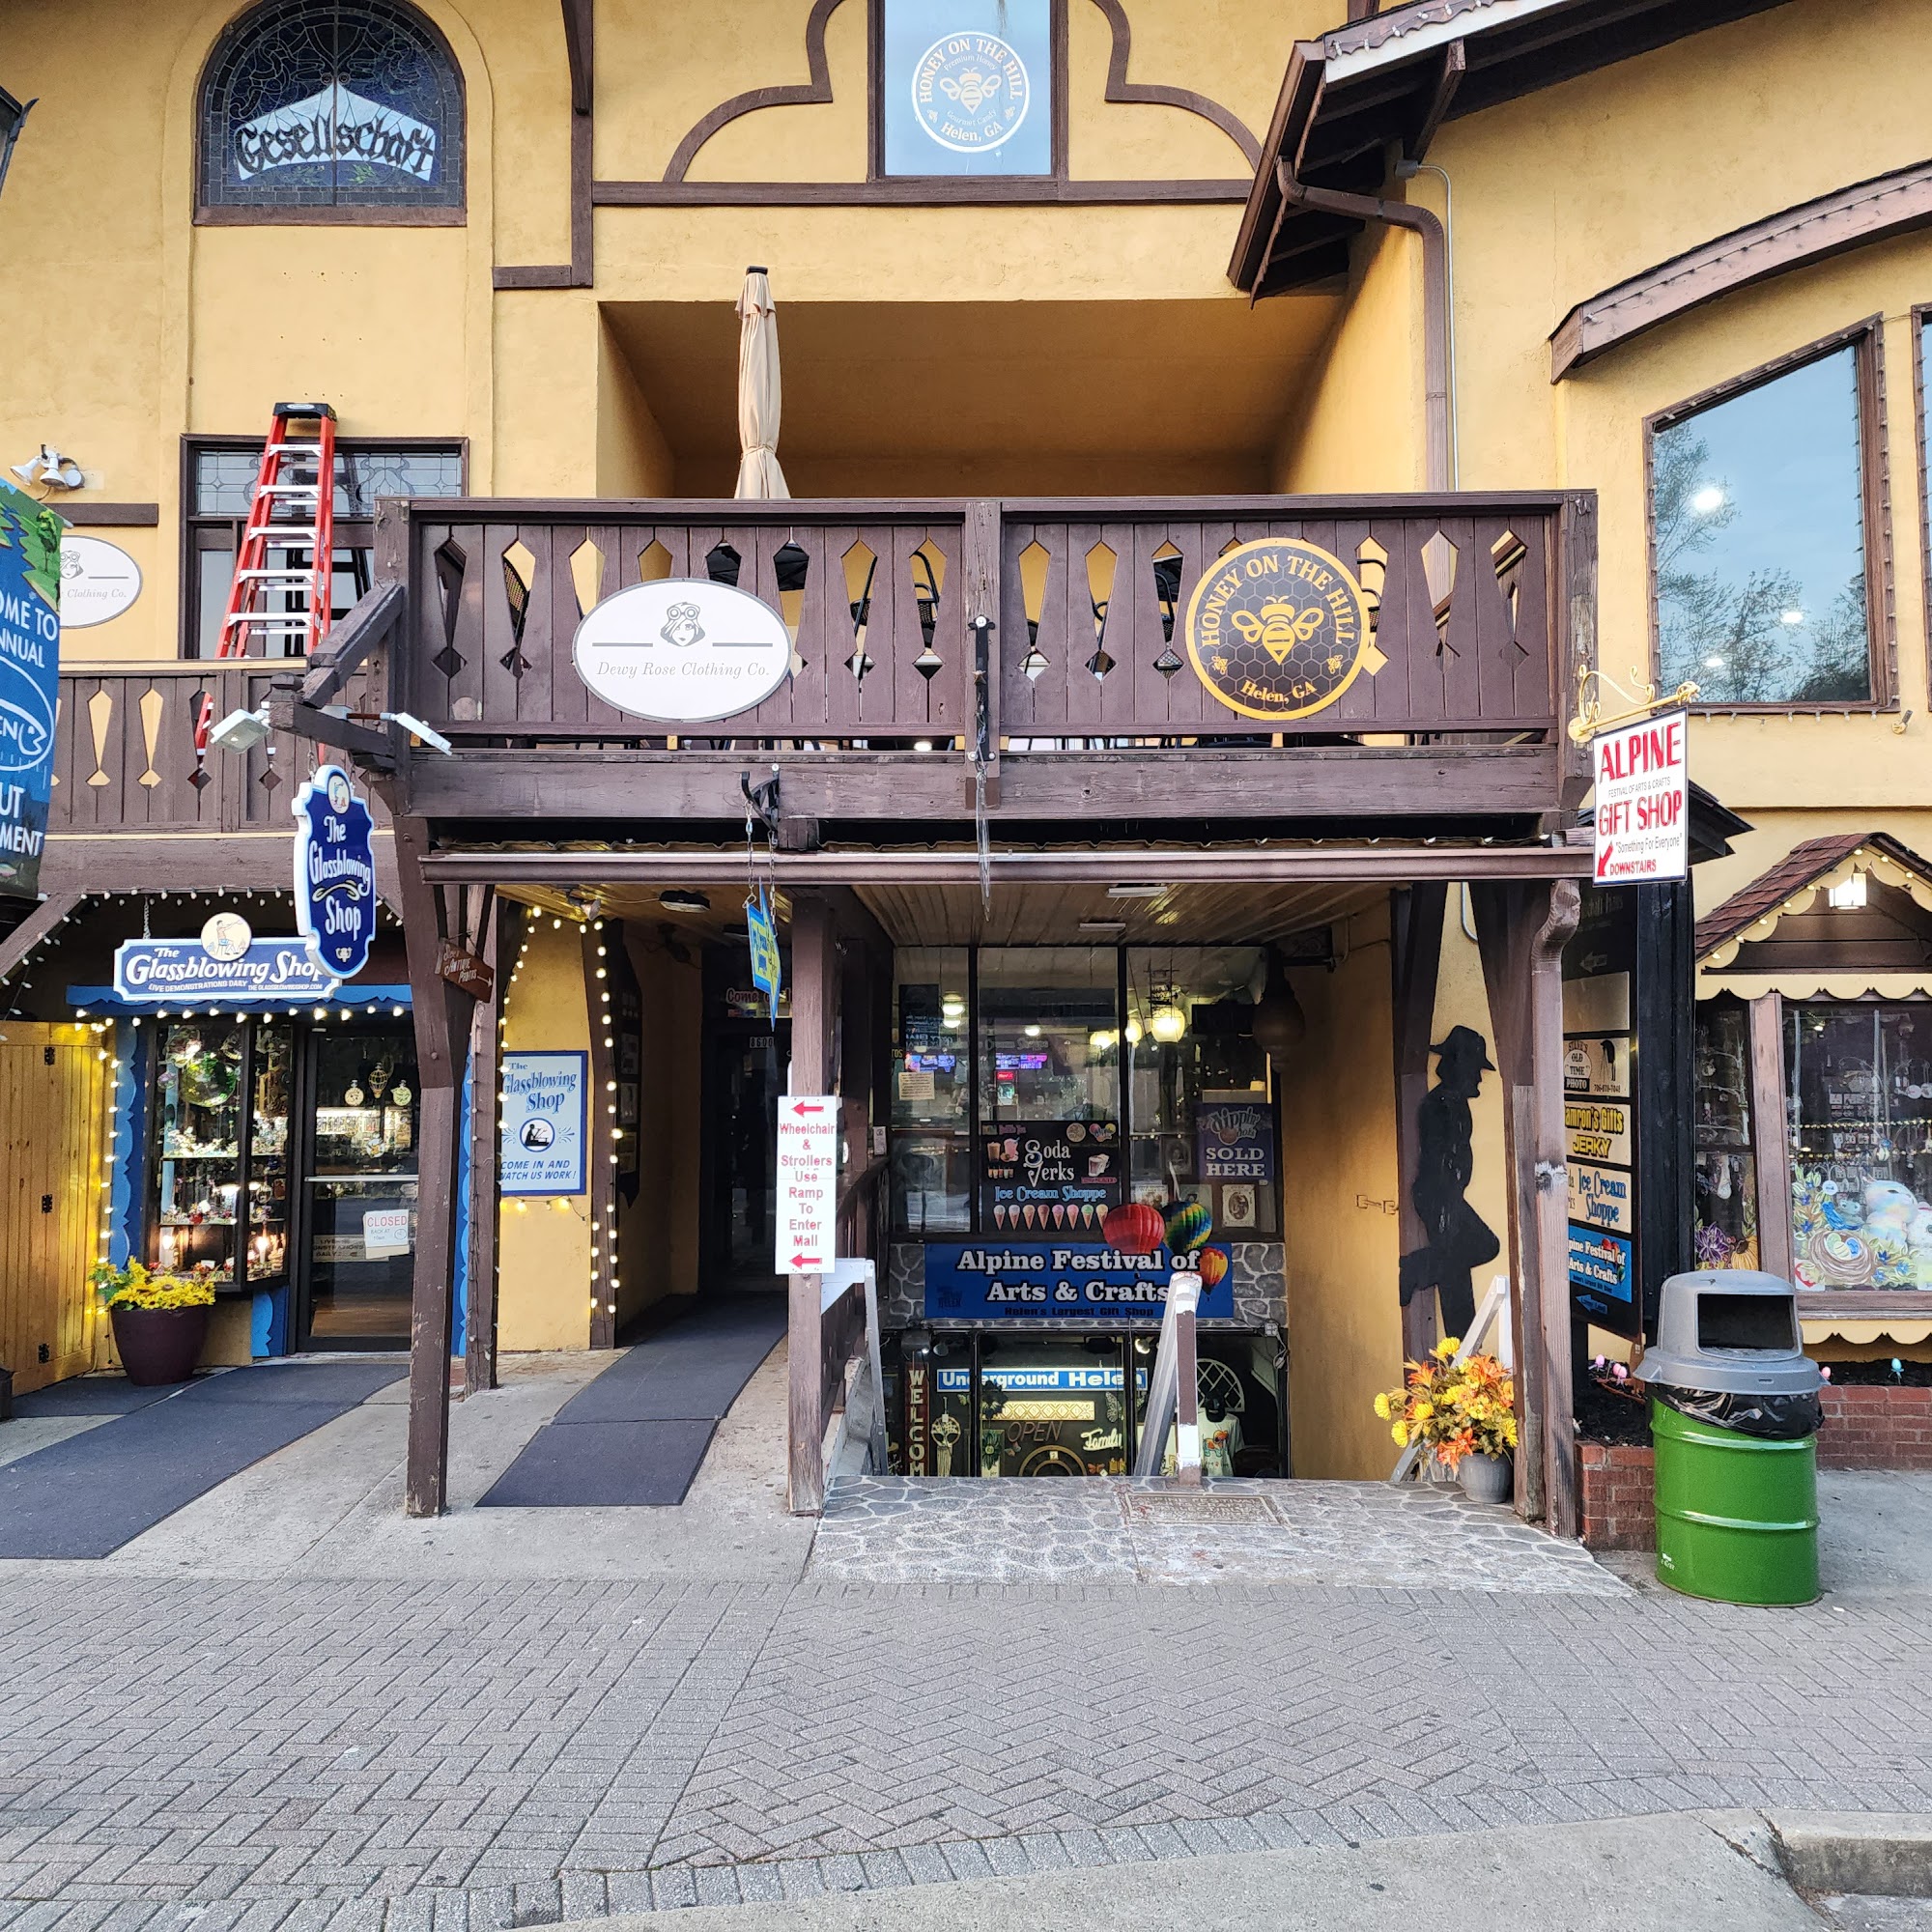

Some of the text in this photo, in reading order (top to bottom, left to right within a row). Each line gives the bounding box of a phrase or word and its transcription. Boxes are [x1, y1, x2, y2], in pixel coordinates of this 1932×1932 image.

[919, 38, 1023, 103] HONEY ON THE HILL
[943, 54, 998, 71] Premium Honey
[977, 108, 997, 125] Candy
[940, 121, 1004, 142] Helen, GA
[67, 588, 107, 600] Clothing
[111, 588, 127, 598] Co.
[1201, 554, 1354, 647] HONEY ON THE HILL
[35, 607, 58, 641] TO
[596, 662, 770, 679] Dewy Rose Clothing Co.
[1240, 680, 1318, 704] Helen, GA
[1599, 722, 1682, 784] ALPINE
[1607, 787, 1628, 798] FESTIVAL
[1629, 784, 1635, 794] OF
[1635, 781, 1647, 792] ARTS
[1652, 777, 1671, 789] CRAFTS
[1599, 789, 1683, 837] GIFT SHOP
[324, 815, 347, 843] The
[1644, 837, 1654, 850] For
[308, 840, 372, 896] Glassblowing
[1609, 858, 1657, 876] DOWNSTAIRS
[325, 895, 362, 942] Shop
[154, 947, 181, 958] The
[125, 954, 270, 984] Glassblowing
[148, 980, 248, 993] LIVE DEMONSTRATIONS DAILY
[726, 987, 759, 1005] Come
[508, 1062, 528, 1070] The
[1571, 1052, 1583, 1063] OLD
[1570, 1065, 1585, 1076] TIME
[502, 1071, 578, 1095] Glassblowing
[1566, 1078, 1587, 1090] PHOTO
[526, 1092, 565, 1114] Shop
[780, 1122, 835, 1135] Wheelchair
[1601, 1106, 1625, 1135] Gifts
[802, 1139, 811, 1151] &
[1024, 1140, 1071, 1165] Soda
[1206, 1147, 1264, 1160] SOLD
[1572, 1134, 1612, 1159] JERKY
[501, 1159, 571, 1170] COME IN AND
[781, 1154, 833, 1167] Strollers
[530, 1171, 543, 1179] US
[795, 1170, 818, 1182] Use
[1024, 1161, 1075, 1188] Jerks
[1206, 1163, 1265, 1177] HERE
[1577, 1167, 1591, 1195] Ice
[1594, 1170, 1627, 1200] Cream
[788, 1186, 824, 1201] Ramp
[994, 1185, 1107, 1203] Ice Cream Shoppe
[799, 1203, 813, 1214] To
[1586, 1193, 1620, 1227] Shoppe
[367, 1215, 408, 1228] CLOSED
[788, 1219, 822, 1231] Enter
[793, 1235, 818, 1247] Mall
[956, 1249, 1201, 1275] Alpine Festival of
[1585, 1240, 1616, 1264] Festival
[1617, 1251, 1627, 1266] of
[1568, 1257, 1584, 1274] Arts
[1585, 1263, 1593, 1275] &
[1593, 1264, 1618, 1286] Crafts
[986, 1281, 1046, 1302] Arts
[1054, 1281, 1078, 1302] &
[1085, 1281, 1169, 1302] Crafts
[1005, 1307, 1153, 1318] Helen's Largest Gift Shop
[942, 1371, 1060, 1388] Unerground
[1007, 1421, 1064, 1442] OPEN
[1080, 1428, 1123, 1451] Family
